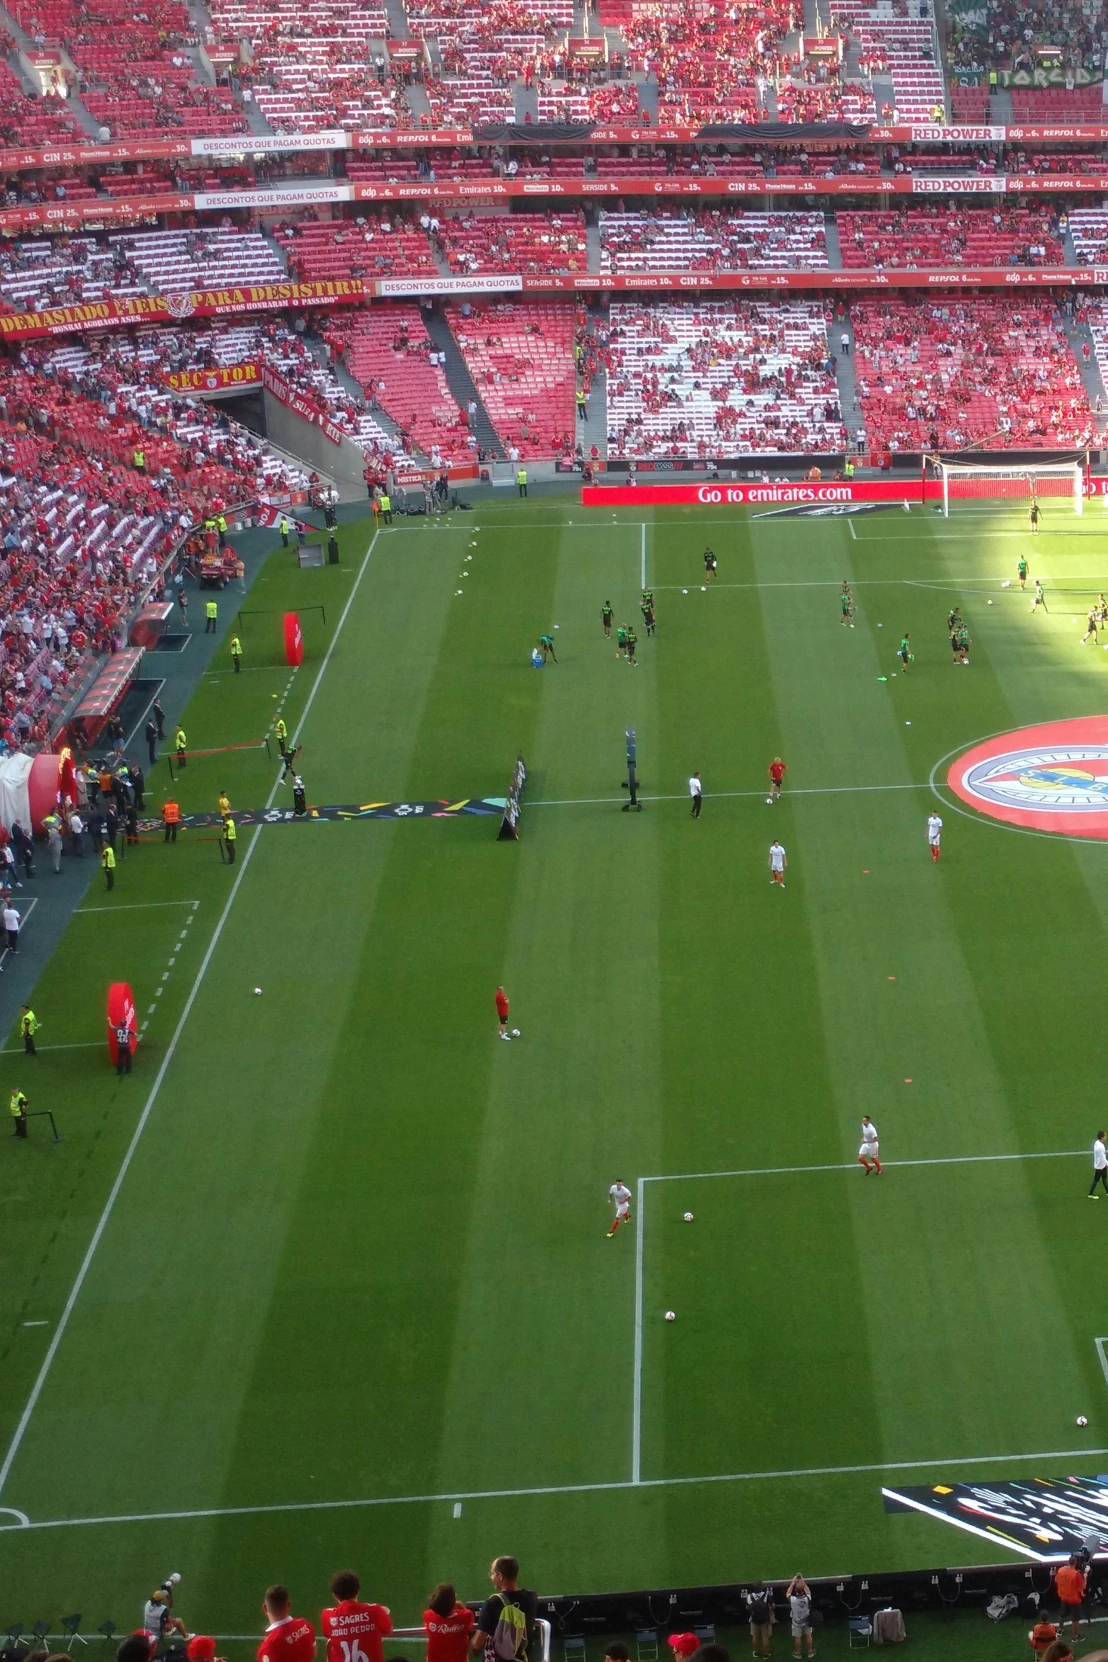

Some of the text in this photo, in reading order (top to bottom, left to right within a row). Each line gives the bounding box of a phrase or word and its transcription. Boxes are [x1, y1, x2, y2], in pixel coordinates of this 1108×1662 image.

[914, 128, 992, 139] RED POWER
[204, 142, 253, 150] DESCONTOS
[303, 137, 336, 146] QUOTAS
[44, 153, 60, 161] CIN
[460, 186, 491, 194] Emirates
[729, 183, 745, 191] CIN
[914, 180, 992, 191] RED POWER
[206, 196, 256, 205] DESCONTOS
[277, 193, 304, 201] PAGAM
[306, 191, 338, 200] QUOTAS
[47, 210, 64, 218] CIN
[385, 279, 519, 291] DESCONTOS QUE PAGAM QUOTAS
[626, 278, 657, 286] Emirates
[680, 277, 697, 285] CIN
[0, 304, 110, 332] DEMASIADO
[190, 288, 245, 307] PARA
[250, 279, 364, 302] DESISTIR!!
[698, 486, 852, 503] Go to emirates.com
[338, 1612, 370, 1626] SAGRES
